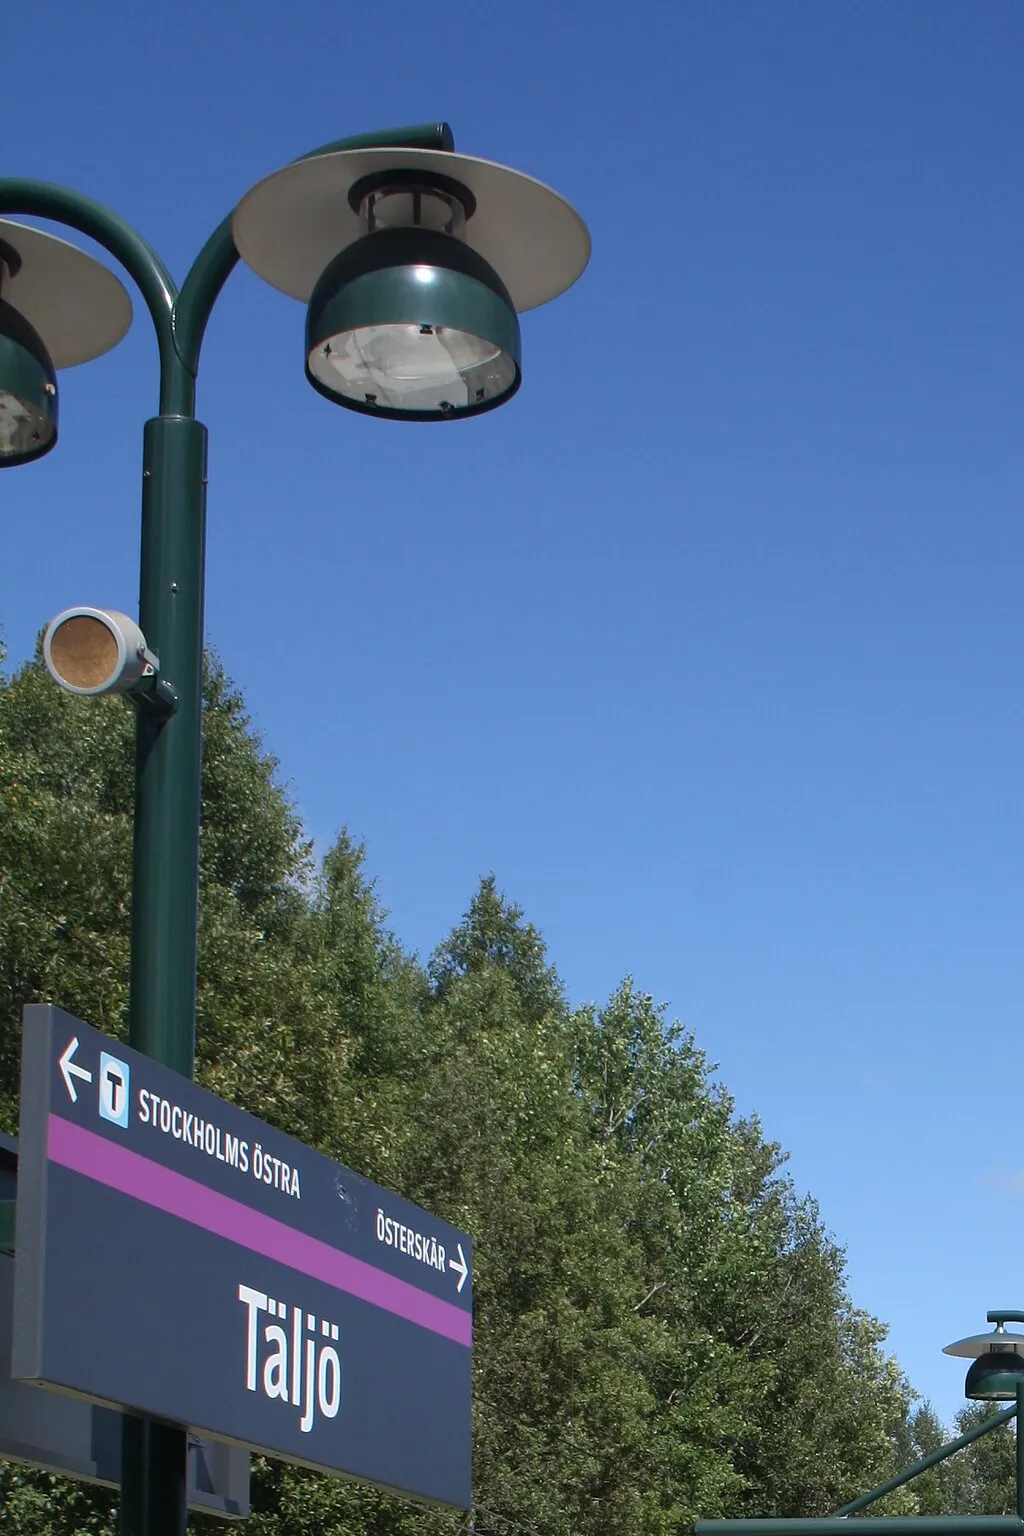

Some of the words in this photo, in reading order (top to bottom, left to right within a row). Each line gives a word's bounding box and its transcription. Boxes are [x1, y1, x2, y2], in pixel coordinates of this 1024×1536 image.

[106, 1071, 123, 1112] T
[138, 1088, 249, 1172] STOCKHOLMS
[253, 1143, 301, 1199] ÖSTRA
[375, 1208, 446, 1274] ÖSTERSKÄR
[238, 1283, 342, 1433] Täljö
